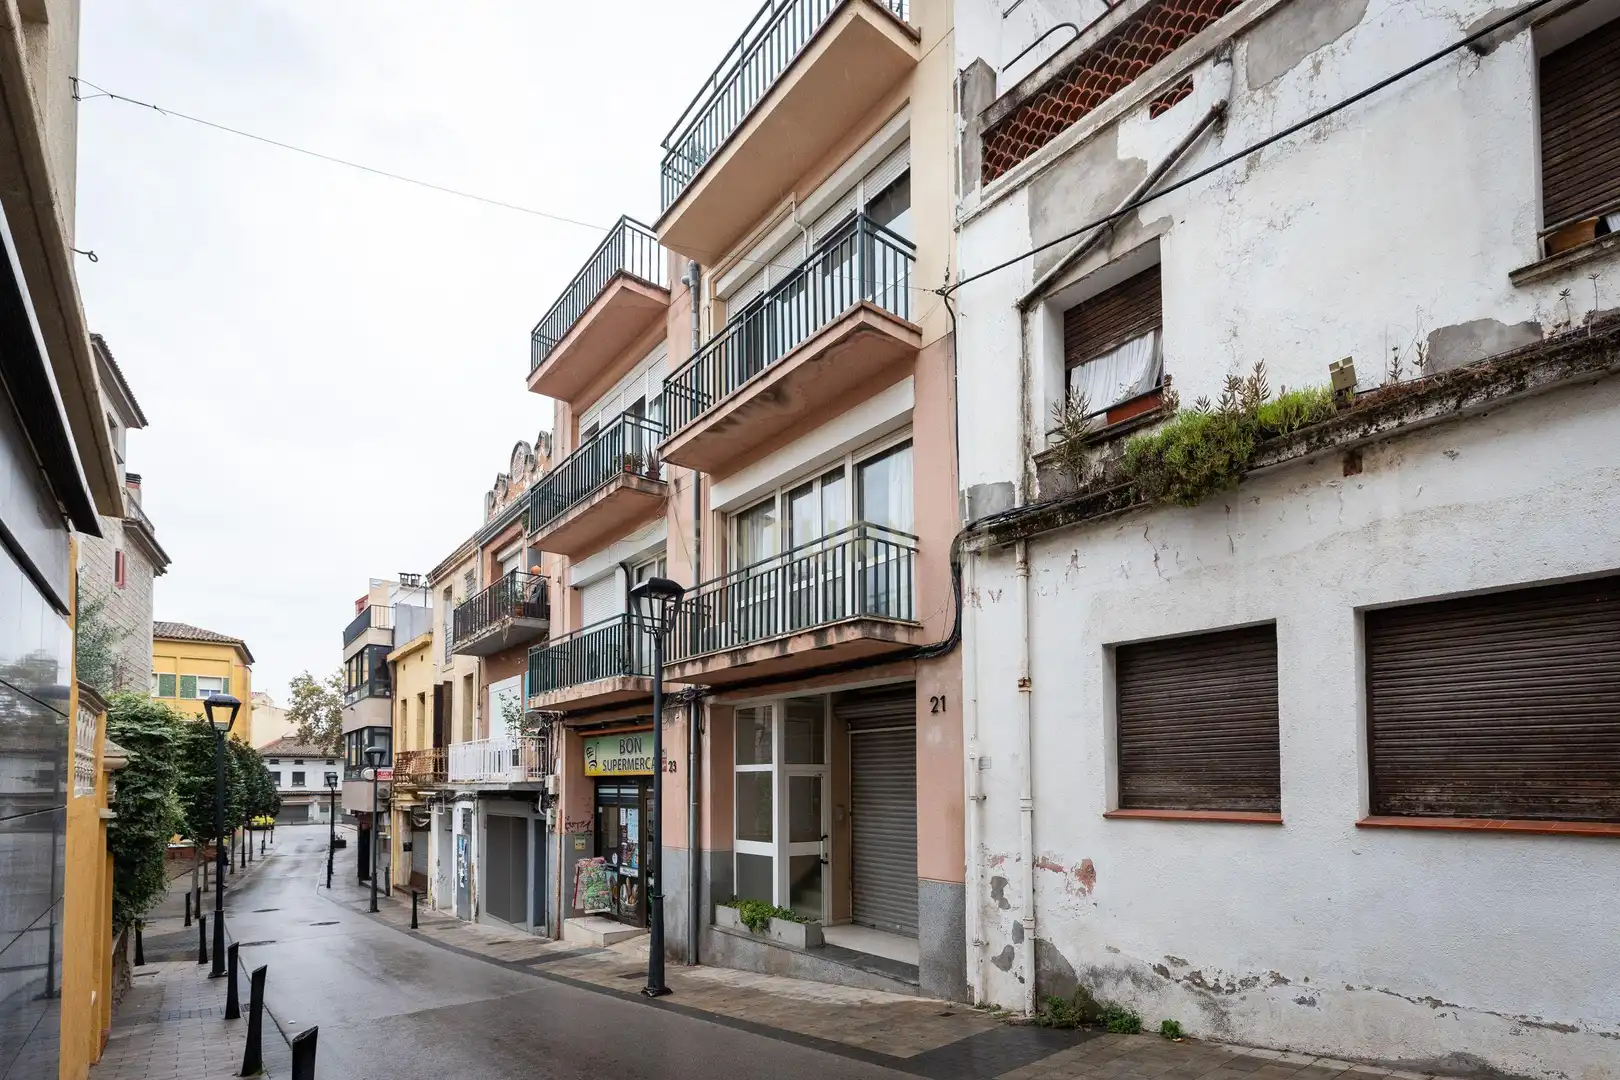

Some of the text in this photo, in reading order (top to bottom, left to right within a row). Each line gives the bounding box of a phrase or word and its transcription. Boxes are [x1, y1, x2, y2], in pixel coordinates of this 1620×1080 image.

[930, 695, 946, 713] 21
[619, 737, 642, 754] BON
[668, 760, 677, 773] 23
